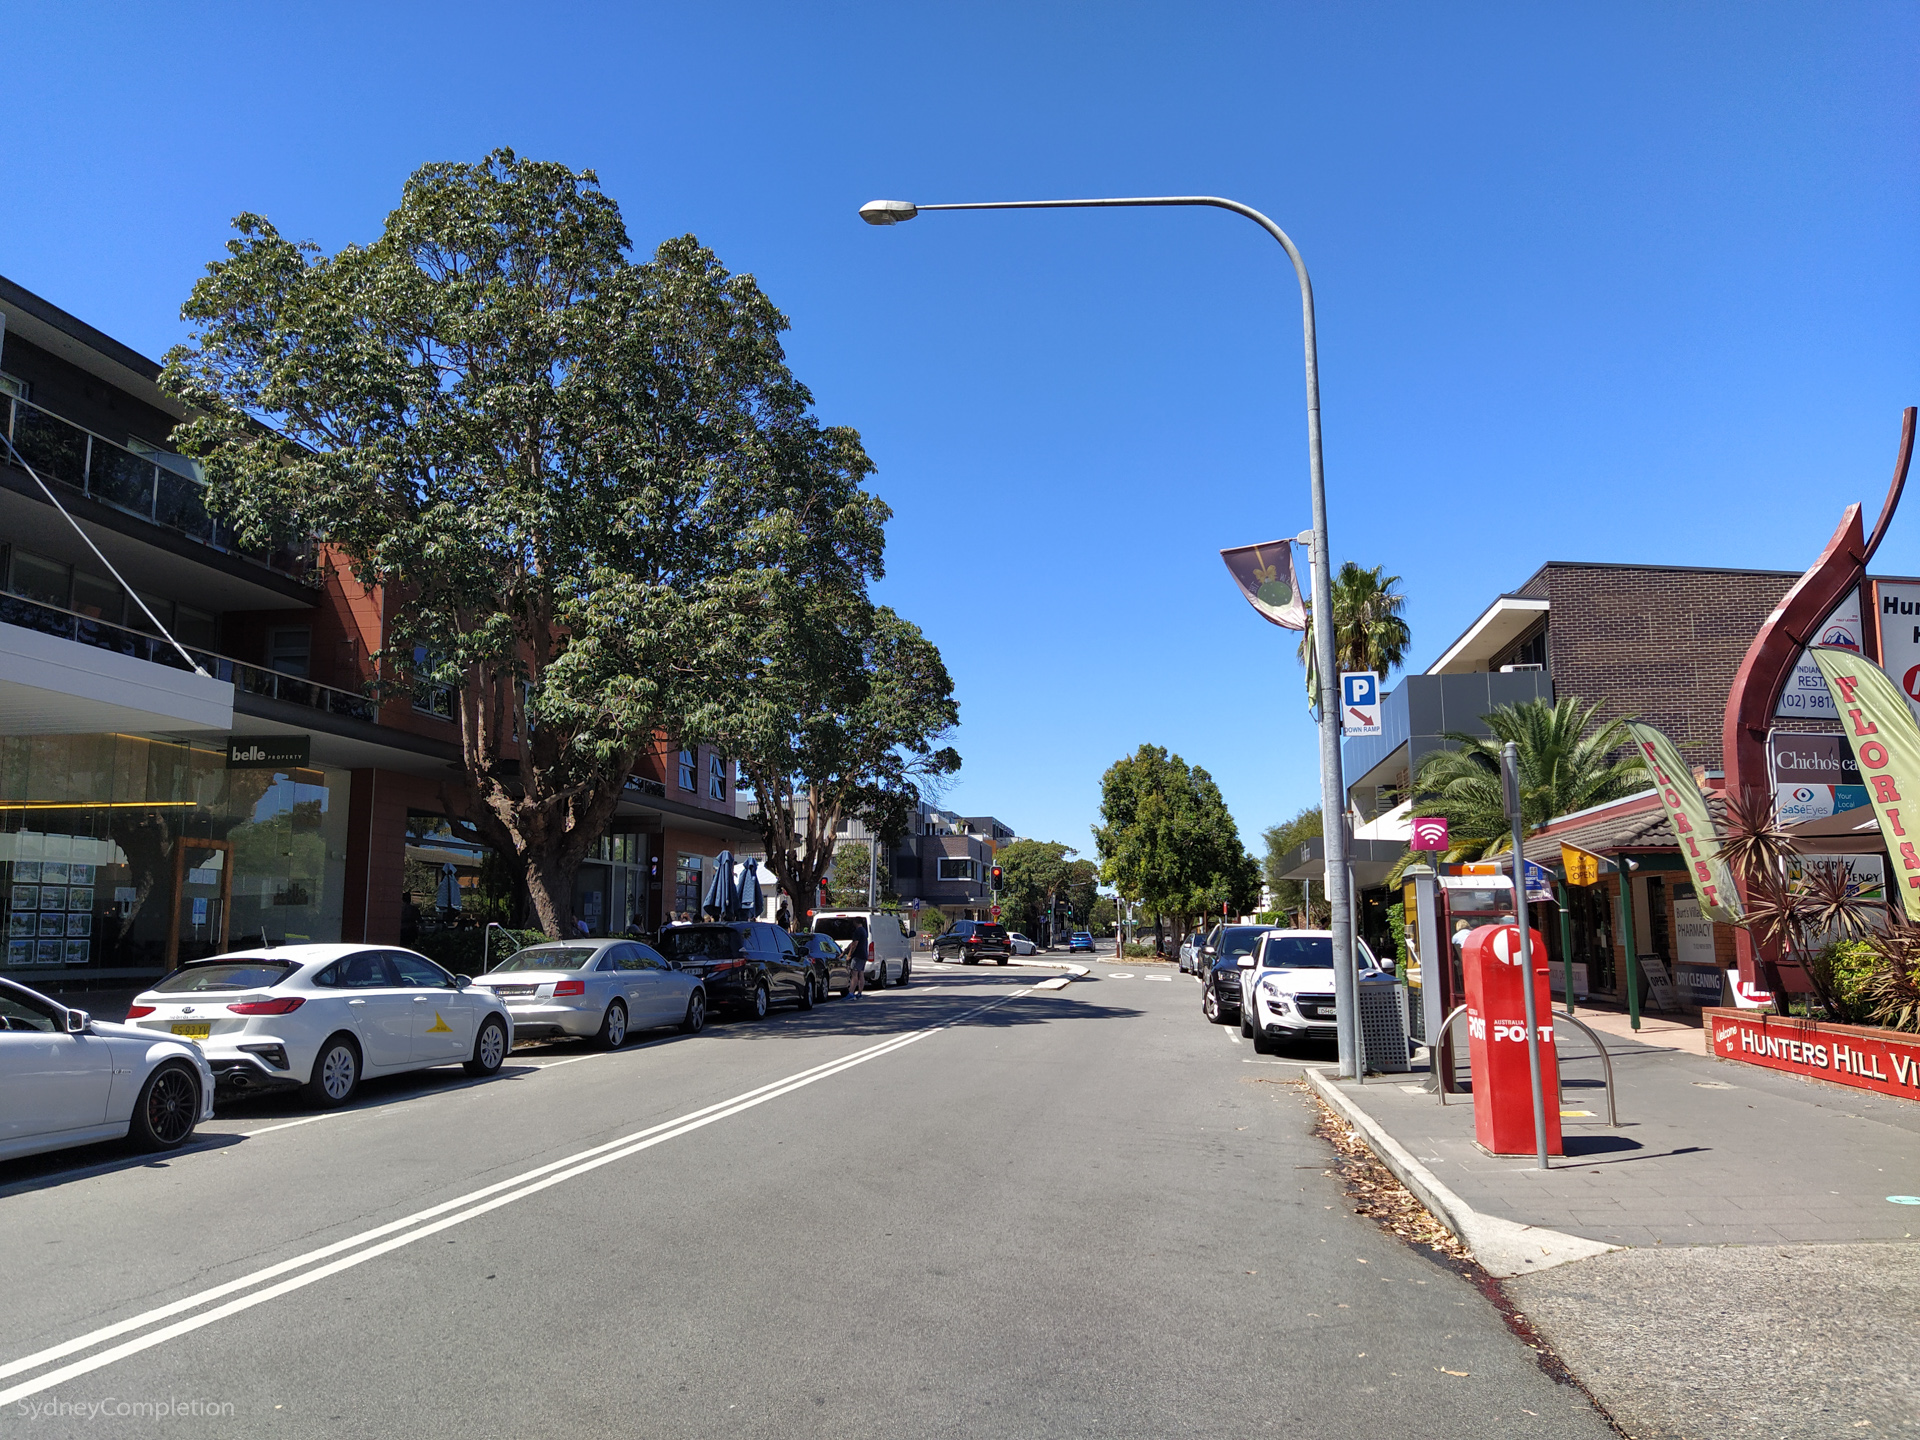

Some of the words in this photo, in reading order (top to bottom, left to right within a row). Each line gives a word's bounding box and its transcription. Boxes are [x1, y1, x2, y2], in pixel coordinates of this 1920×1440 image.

[1352, 679, 1370, 702] P
[1782, 693, 1806, 709] (02)
[232, 746, 266, 761] belle
[1776, 751, 1840, 771] Chicho's
[1641, 741, 1719, 907] FLORIST
[1572, 871, 1595, 880] OPEN
[1689, 907, 1704, 920] Villag
[1677, 924, 1711, 937] PHARMACY
[1650, 976, 1669, 987] OPEN
[1676, 972, 1689, 986] DRY
[1689, 973, 1721, 989] CLEANING
[1468, 1015, 1486, 1041] POST
[1715, 1025, 1738, 1043] Welcome
[1726, 1041, 1734, 1052] to
[1833, 1043, 1887, 1081] HILL
